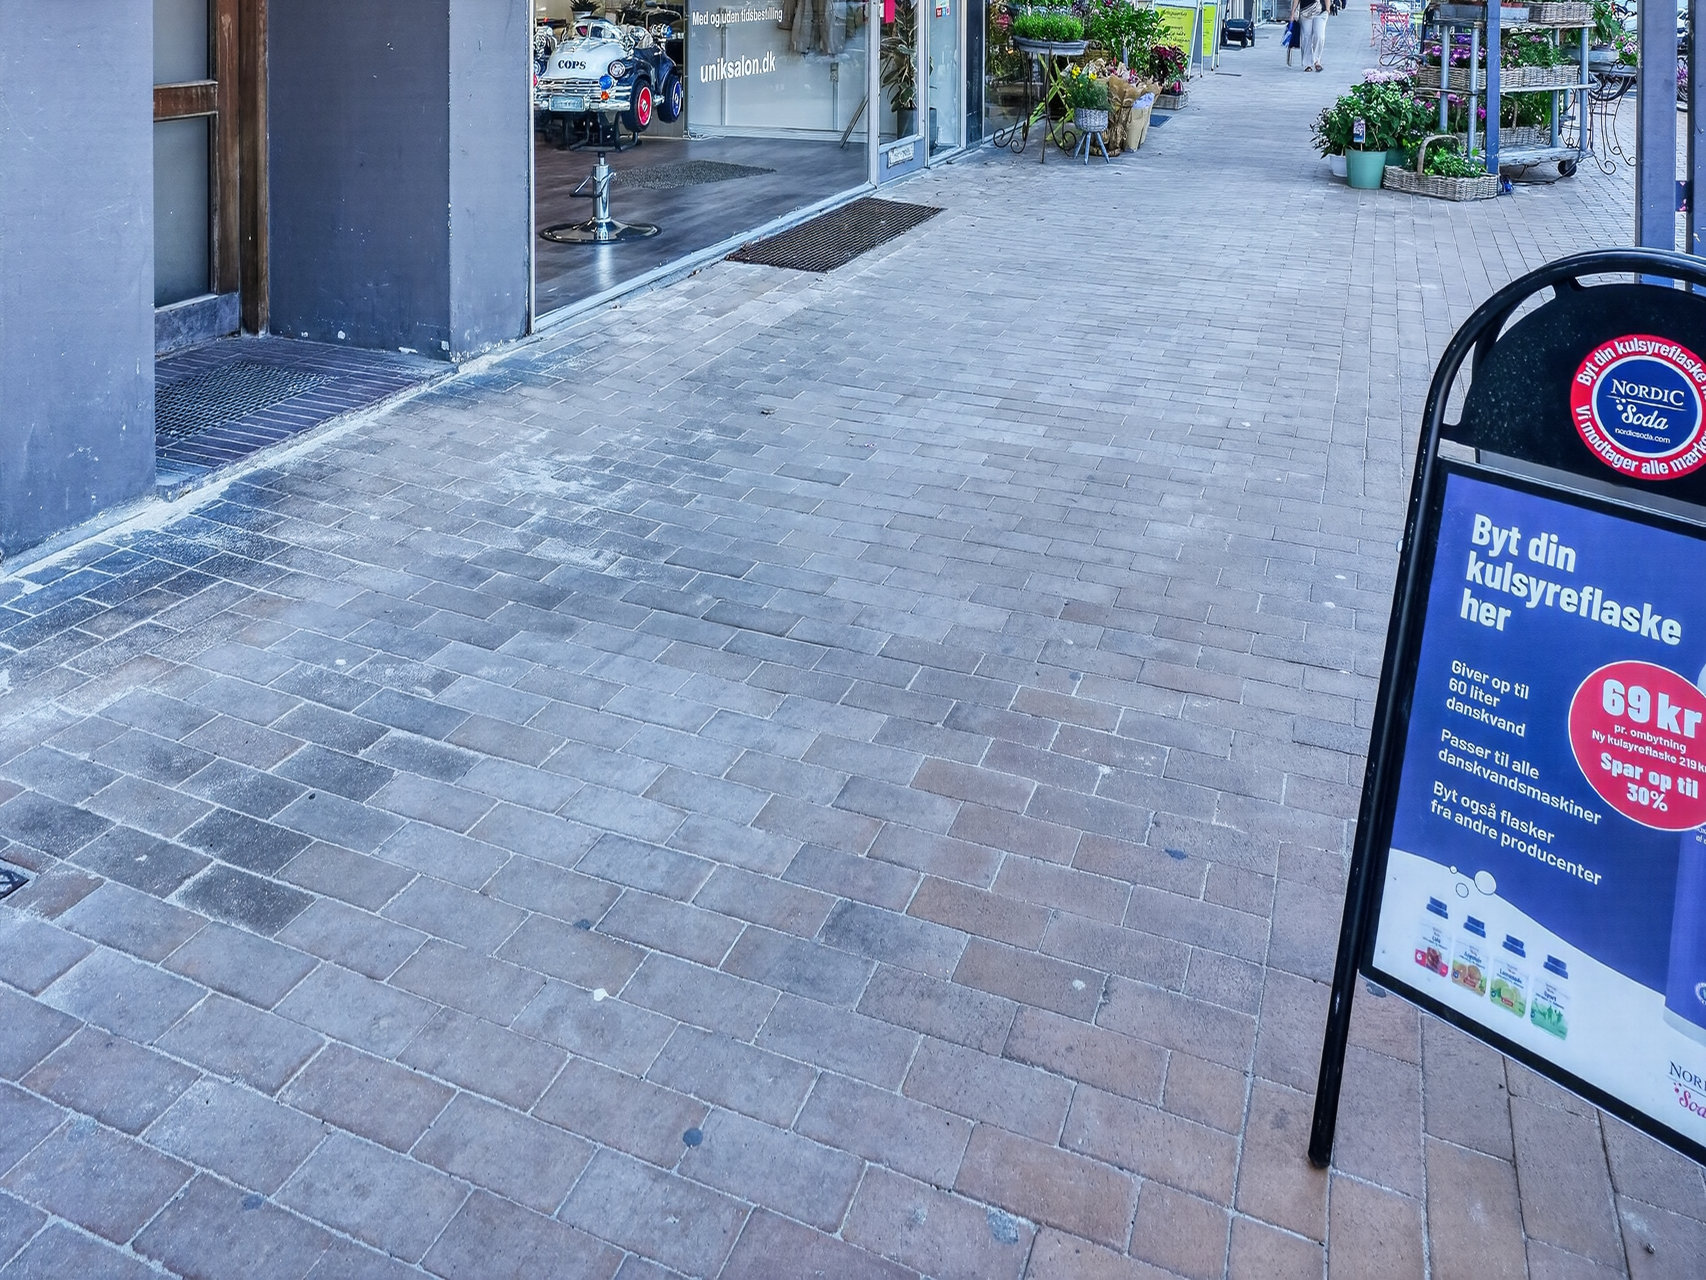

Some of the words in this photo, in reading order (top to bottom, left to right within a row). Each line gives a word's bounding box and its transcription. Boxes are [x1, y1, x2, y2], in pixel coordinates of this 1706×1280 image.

[692, 11, 709, 26] Med
[710, 12, 720, 28] og
[721, 8, 740, 24] uden
[740, 7, 783, 24] tidsbestilling
[557, 59, 586, 70] COPS
[700, 51, 776, 83] uniksalon.dk
[1576, 361, 1599, 386] Byt
[1594, 347, 1617, 367] din
[1613, 337, 1706, 384] kulsyreflaske
[1575, 404, 1592, 421] Vi
[1610, 378, 1686, 407] NORDIC
[1615, 427, 1671, 444] nordicsoda.com
[1621, 404, 1669, 430] Soda
[1580, 421, 1639, 472] modtager
[1641, 459, 1669, 475] alle
[1471, 513, 1522, 558] Byt
[1527, 532, 1577, 573] din
[1459, 587, 1512, 632] her
[1465, 549, 1683, 646] kulsyreflaske
[1448, 677, 1468, 696] 60
[1469, 684, 1501, 709] liter
[1451, 659, 1490, 685] Giver
[1491, 677, 1511, 694] op
[1513, 682, 1530, 700] til
[1445, 696, 1527, 738] danskvand
[1602, 678, 1651, 724] 69
[1656, 691, 1703, 739] kr
[1440, 728, 1492, 760] Passer
[1494, 749, 1510, 768] til
[1511, 756, 1540, 780] alle
[1591, 729, 1606, 744] Ny
[1607, 733, 1677, 764] kulsyreflaske
[1678, 756, 1697, 770] 219
[1613, 724, 1628, 735] pr.
[1630, 728, 1688, 754] ombytning
[1437, 748, 1602, 825] danskvandsmaskiner
[1600, 751, 1644, 781] Spar
[1648, 769, 1672, 793] op
[1676, 776, 1699, 800] til
[1433, 780, 1458, 803] Byt
[1460, 795, 1497, 820] også
[1499, 810, 1555, 844] flasker
[1626, 782, 1669, 813] 30%
[1430, 799, 1452, 820] fra
[1454, 812, 1498, 840] andre
[1500, 832, 1602, 886] producenter
[1669, 1060, 1706, 1092] NOR
